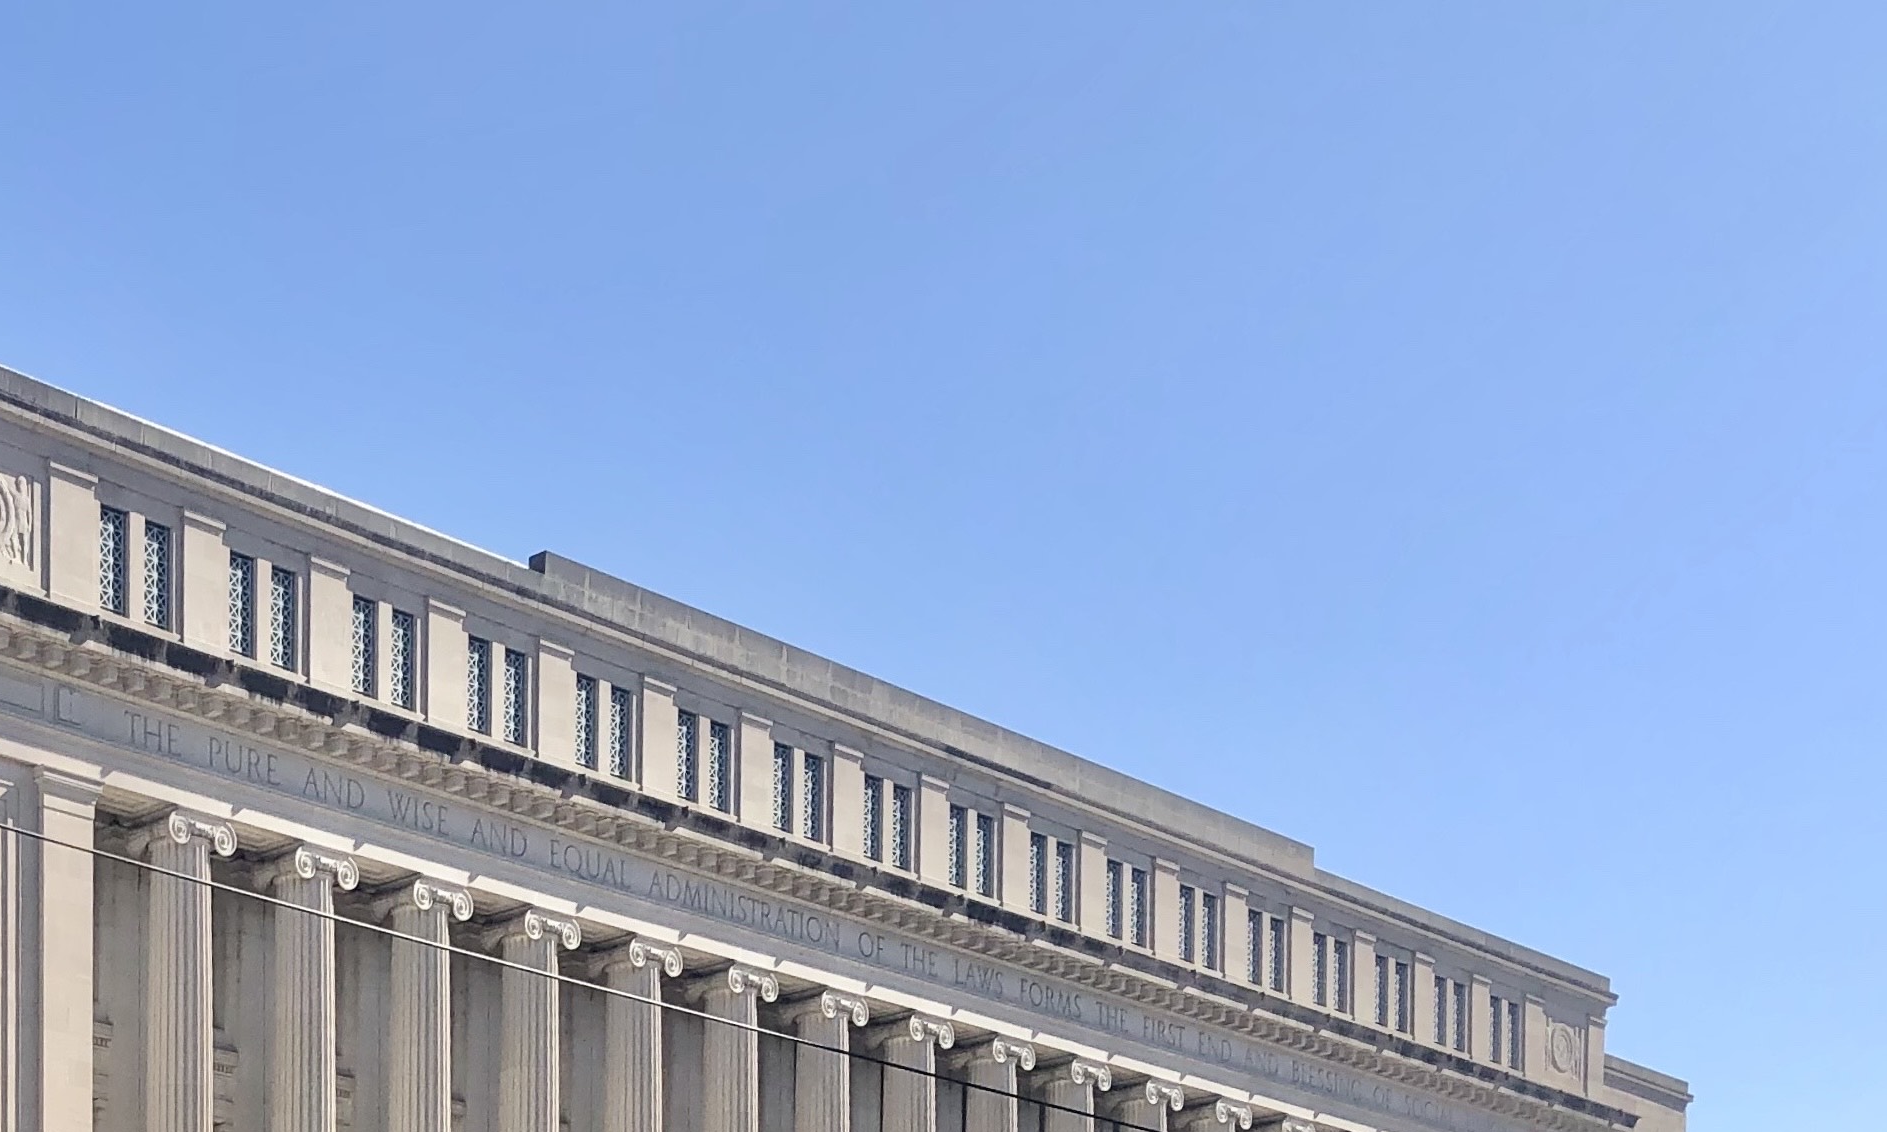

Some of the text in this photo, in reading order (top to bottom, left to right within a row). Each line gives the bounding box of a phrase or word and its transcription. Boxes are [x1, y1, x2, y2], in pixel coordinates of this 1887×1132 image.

[124, 710, 182, 757] THE
[208, 736, 282, 786] PURE
[302, 767, 365, 809] AND
[388, 790, 450, 836] WISE
[470, 818, 528, 858] AND
[549, 839, 632, 890] EQUAL
[648, 869, 841, 955] ADMINISTRATION
[858, 932, 885, 965] OF
[900, 942, 938, 978] THE
[954, 959, 1004, 999] LAWS
[1019, 978, 1082, 1018] FORMS
[1096, 1001, 1128, 1032] THE
[1142, 1016, 1185, 1048] FIRST
[1198, 1031, 1232, 1063] END
